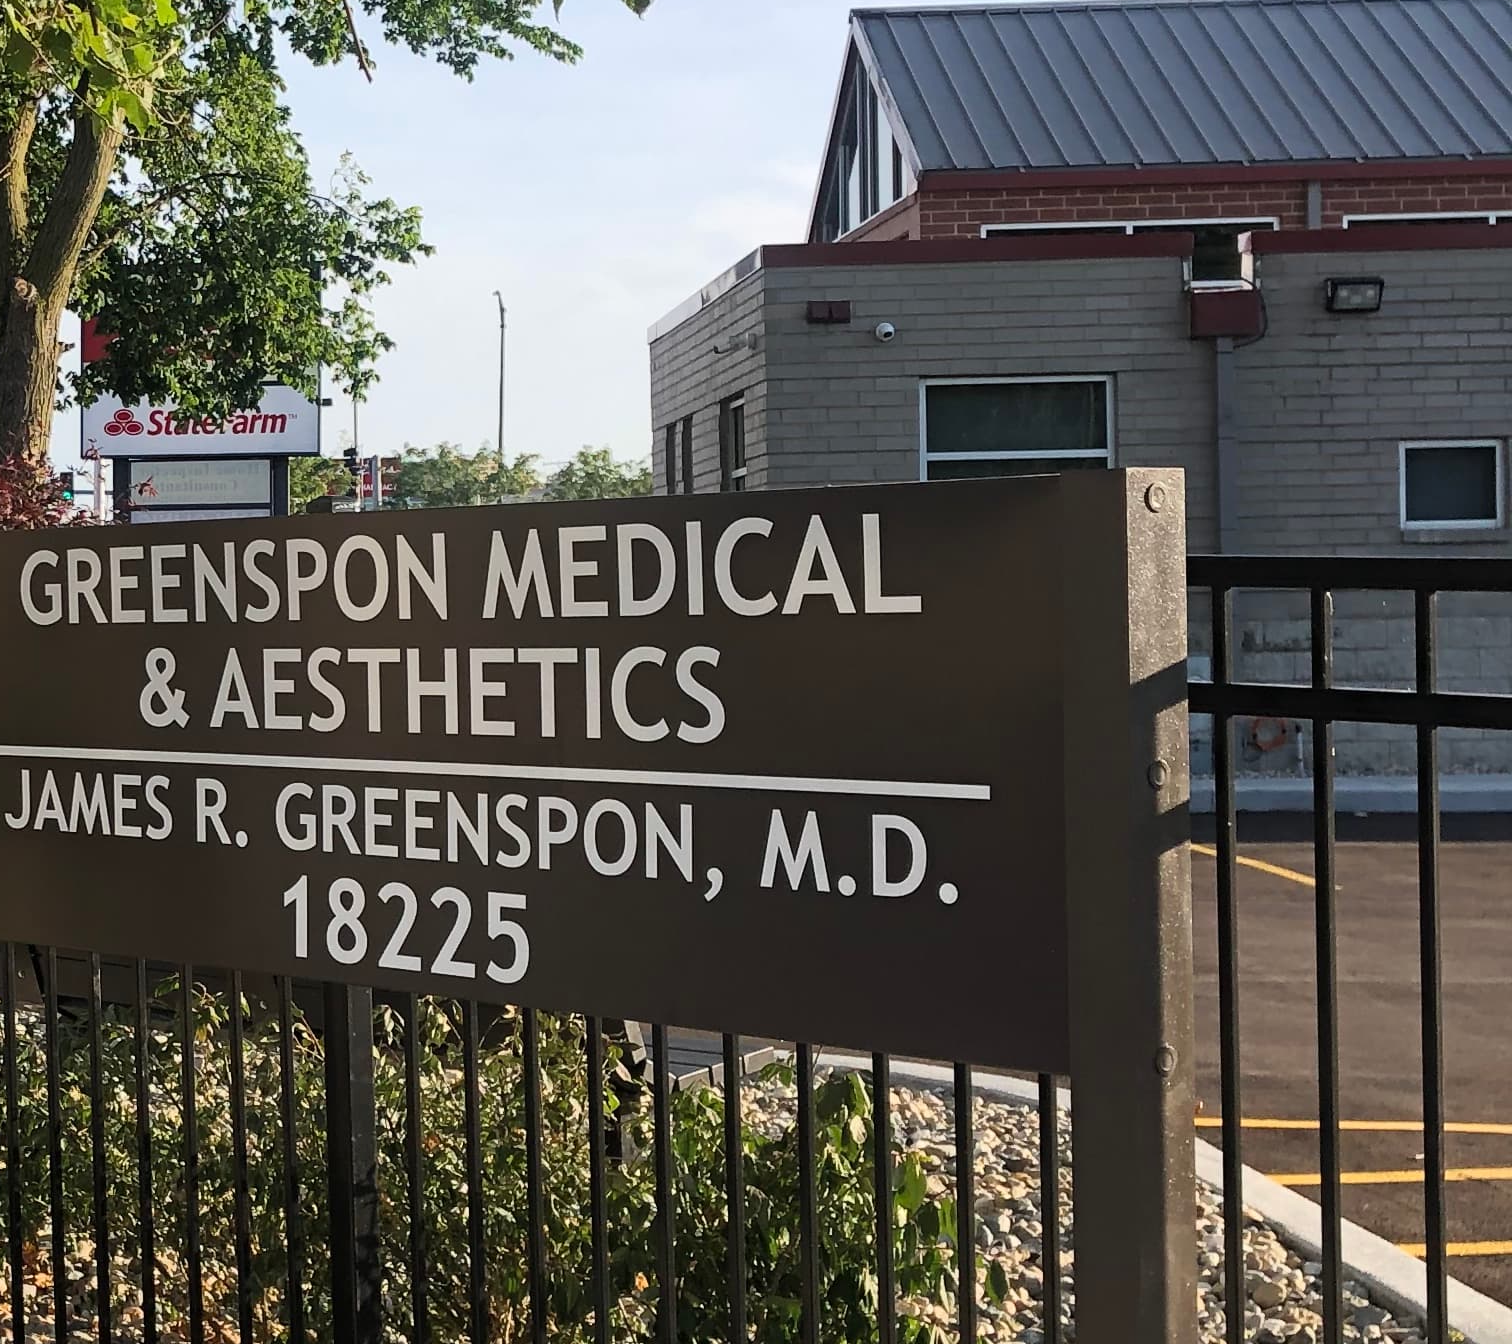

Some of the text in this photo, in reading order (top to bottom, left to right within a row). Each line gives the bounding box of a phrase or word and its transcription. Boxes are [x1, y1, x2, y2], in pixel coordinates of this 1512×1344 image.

[19, 512, 923, 627] GREENSPON MEDICAL
[138, 645, 727, 745] & AESTHETICS
[3, 767, 960, 906] JAMES R. GREENSPON, M.D.
[282, 873, 531, 985] 18225
